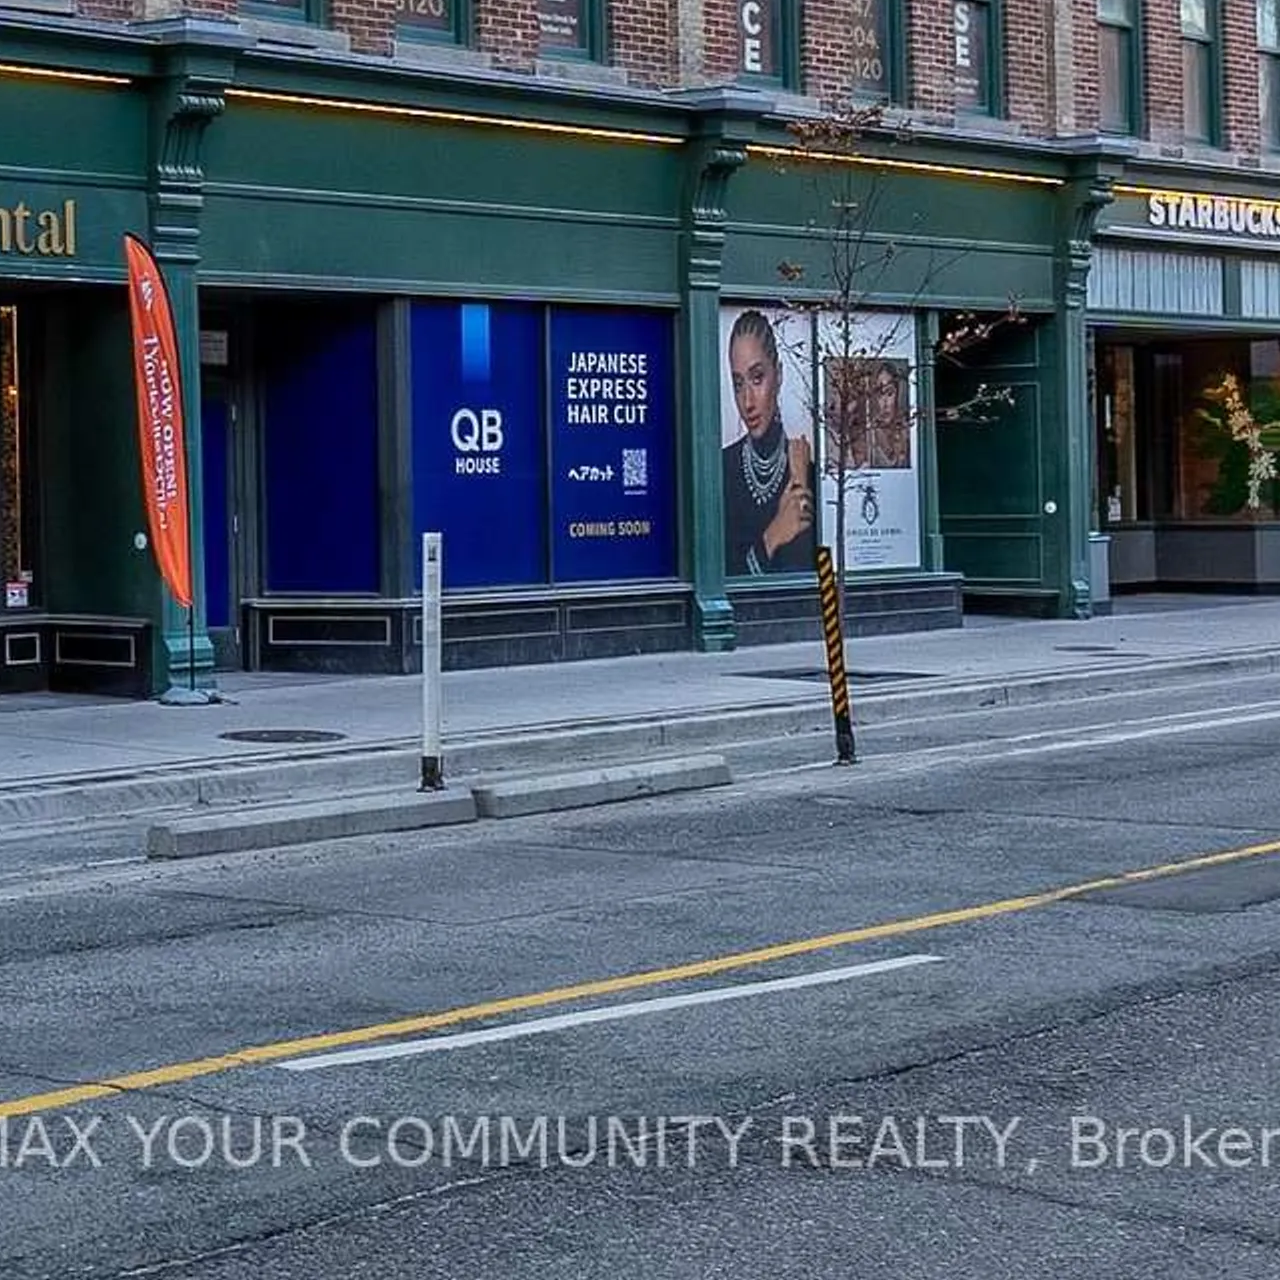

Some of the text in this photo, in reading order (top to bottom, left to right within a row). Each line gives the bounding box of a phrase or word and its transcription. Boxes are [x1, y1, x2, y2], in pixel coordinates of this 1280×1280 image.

[568, 352, 647, 374] JAPANESE
[567, 378, 647, 400] EXPRESS
[568, 404, 648, 424] HAIR CUT
[451, 408, 504, 452] QB
[456, 457, 501, 474] HOUSE
[570, 520, 651, 538] COMING SOON
